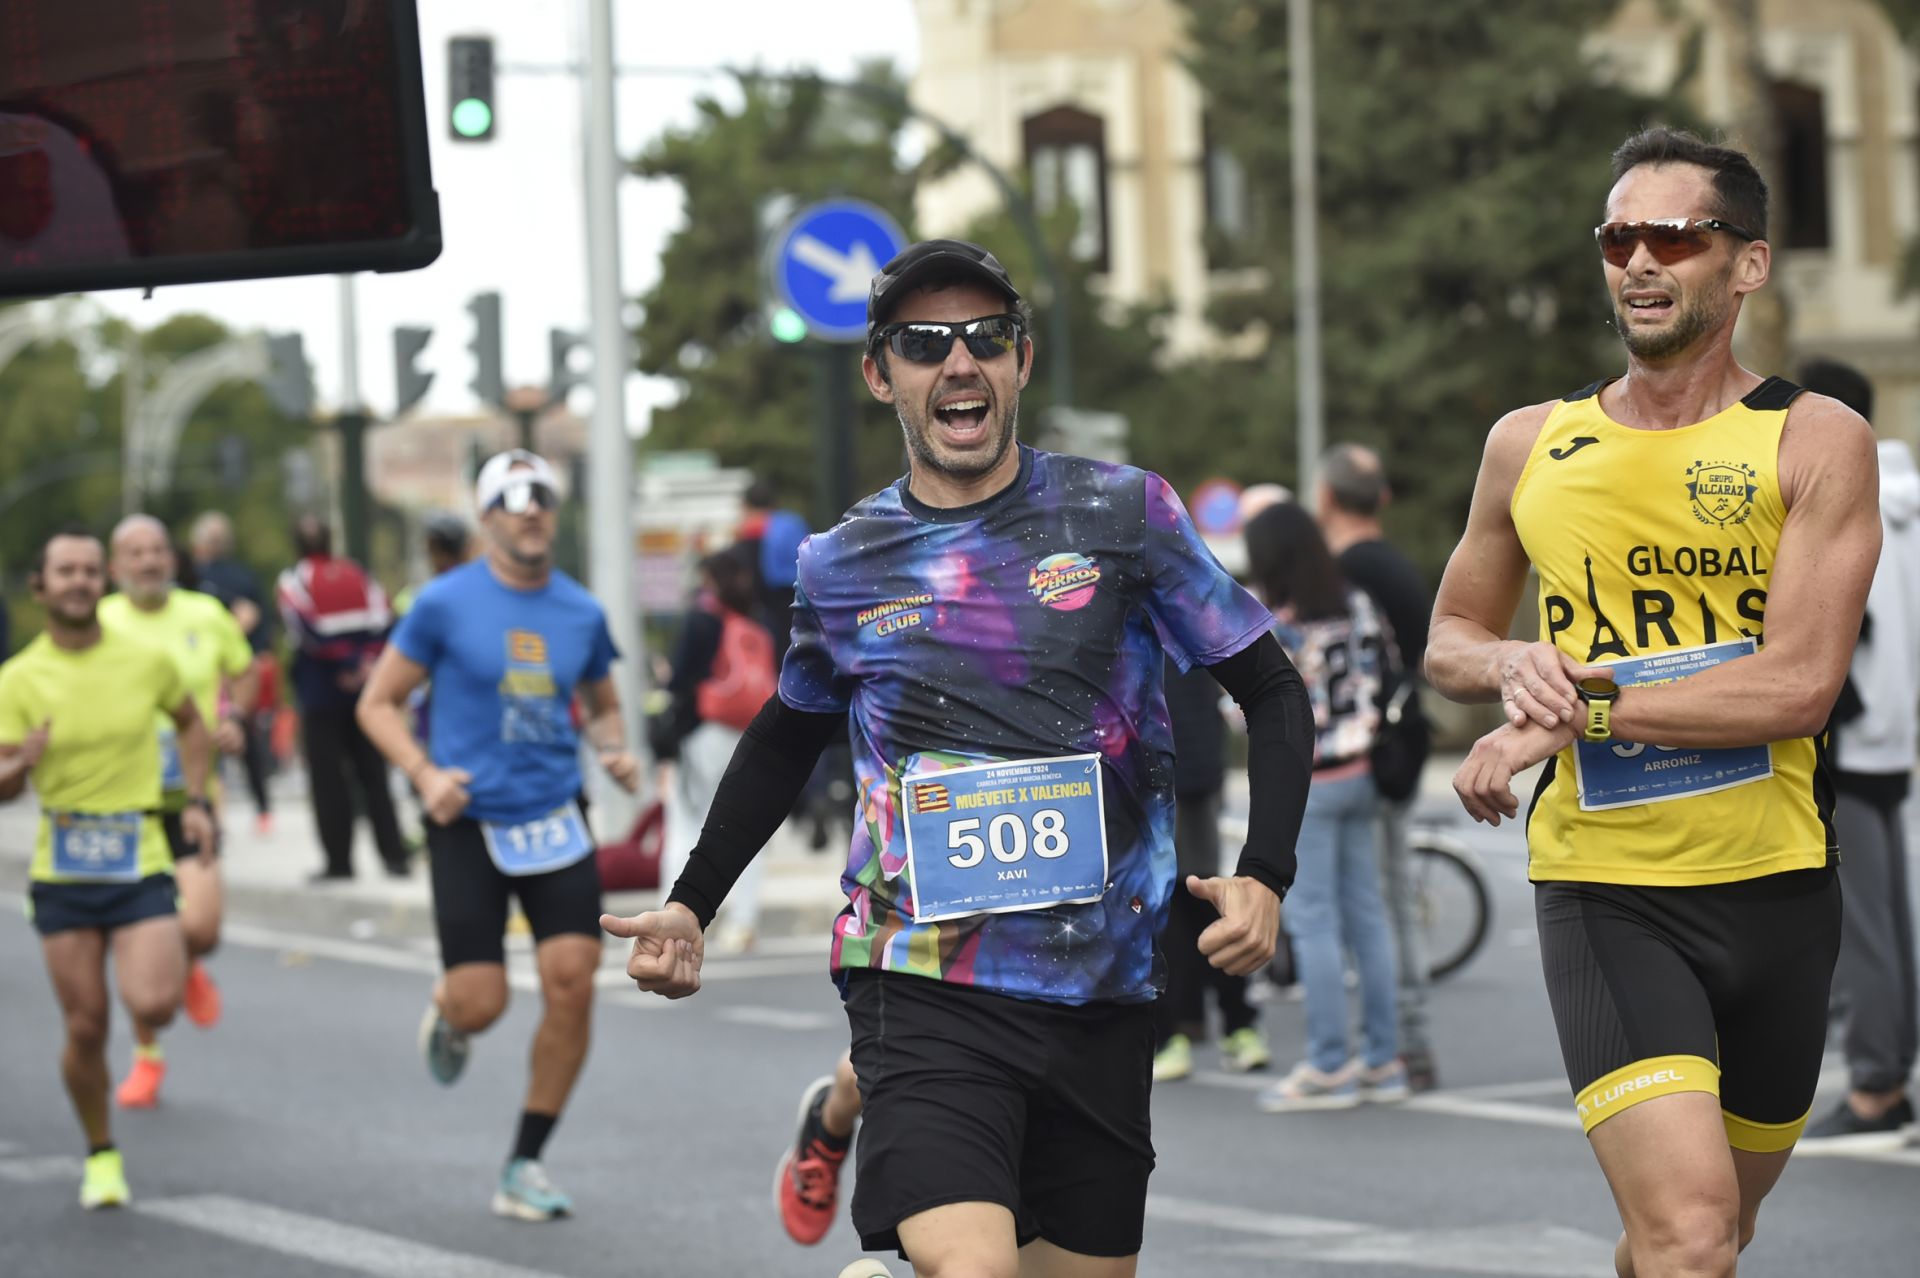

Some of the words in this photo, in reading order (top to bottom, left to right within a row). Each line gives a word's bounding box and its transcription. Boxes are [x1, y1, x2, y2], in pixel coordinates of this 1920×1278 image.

[1698, 484, 1744, 496] ALCARAZ
[1709, 474, 1733, 483] GRUPO
[1627, 545, 1767, 577] GLOBAL
[1035, 566, 1101, 596] PERROS
[856, 593, 934, 626] RUNNING
[1545, 566, 1767, 662] PARIS
[876, 612, 921, 637] CLUB
[1643, 660, 1652, 669] 24
[1653, 654, 1689, 667] NOVIEMBRE
[1690, 651, 1706, 661] 2024
[1655, 666, 1675, 675] POPULAR
[986, 770, 995, 778] 24
[996, 766, 1032, 777] NOVIEMBRE
[1033, 764, 1049, 773] 2024
[1644, 754, 1702, 773] ARRONIZ
[955, 790, 1016, 810] MUÉVETE
[1018, 788, 1029, 801] X
[1032, 781, 1093, 801] VALENCIA
[947, 808, 1070, 869] 508
[997, 869, 1027, 881] XAVI
[1593, 1069, 1685, 1108] LURBEL
